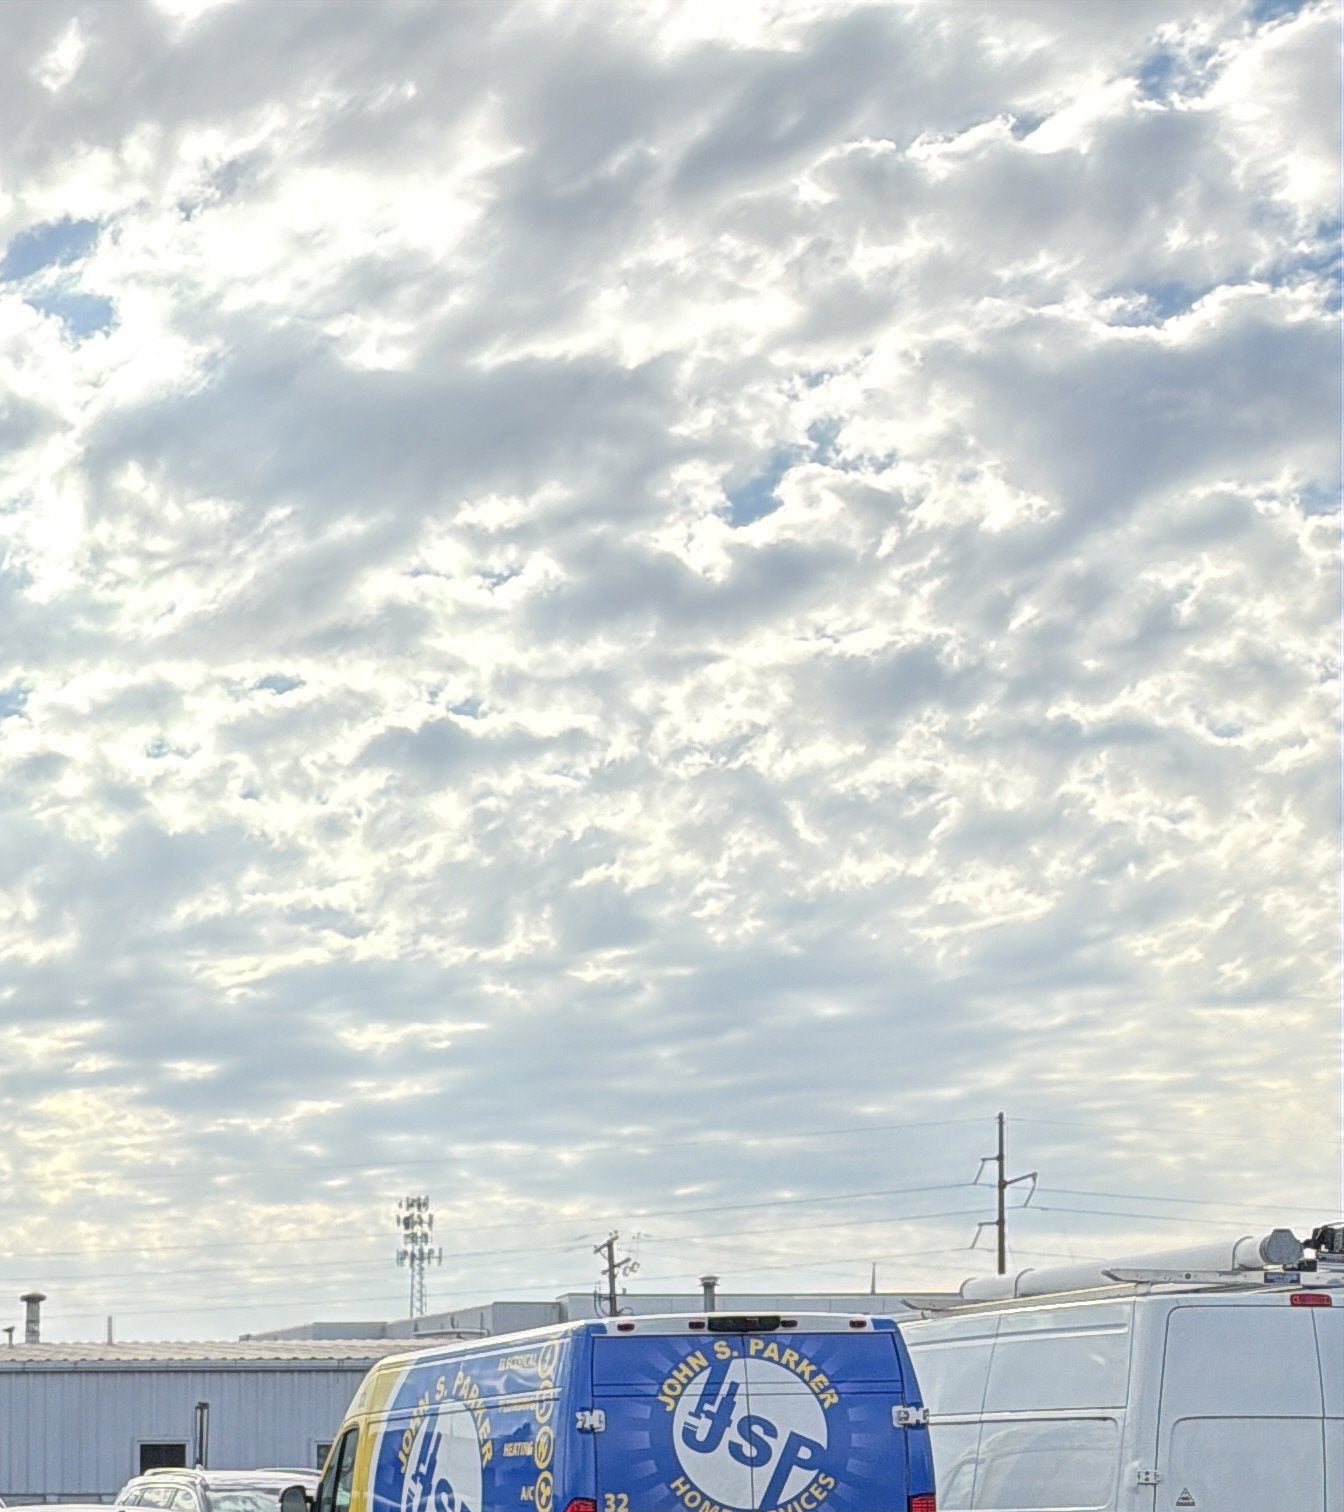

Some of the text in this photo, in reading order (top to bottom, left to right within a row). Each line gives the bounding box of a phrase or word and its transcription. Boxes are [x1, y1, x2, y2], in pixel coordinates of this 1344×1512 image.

[657, 1339, 840, 1412] JOHN S. PARKER
